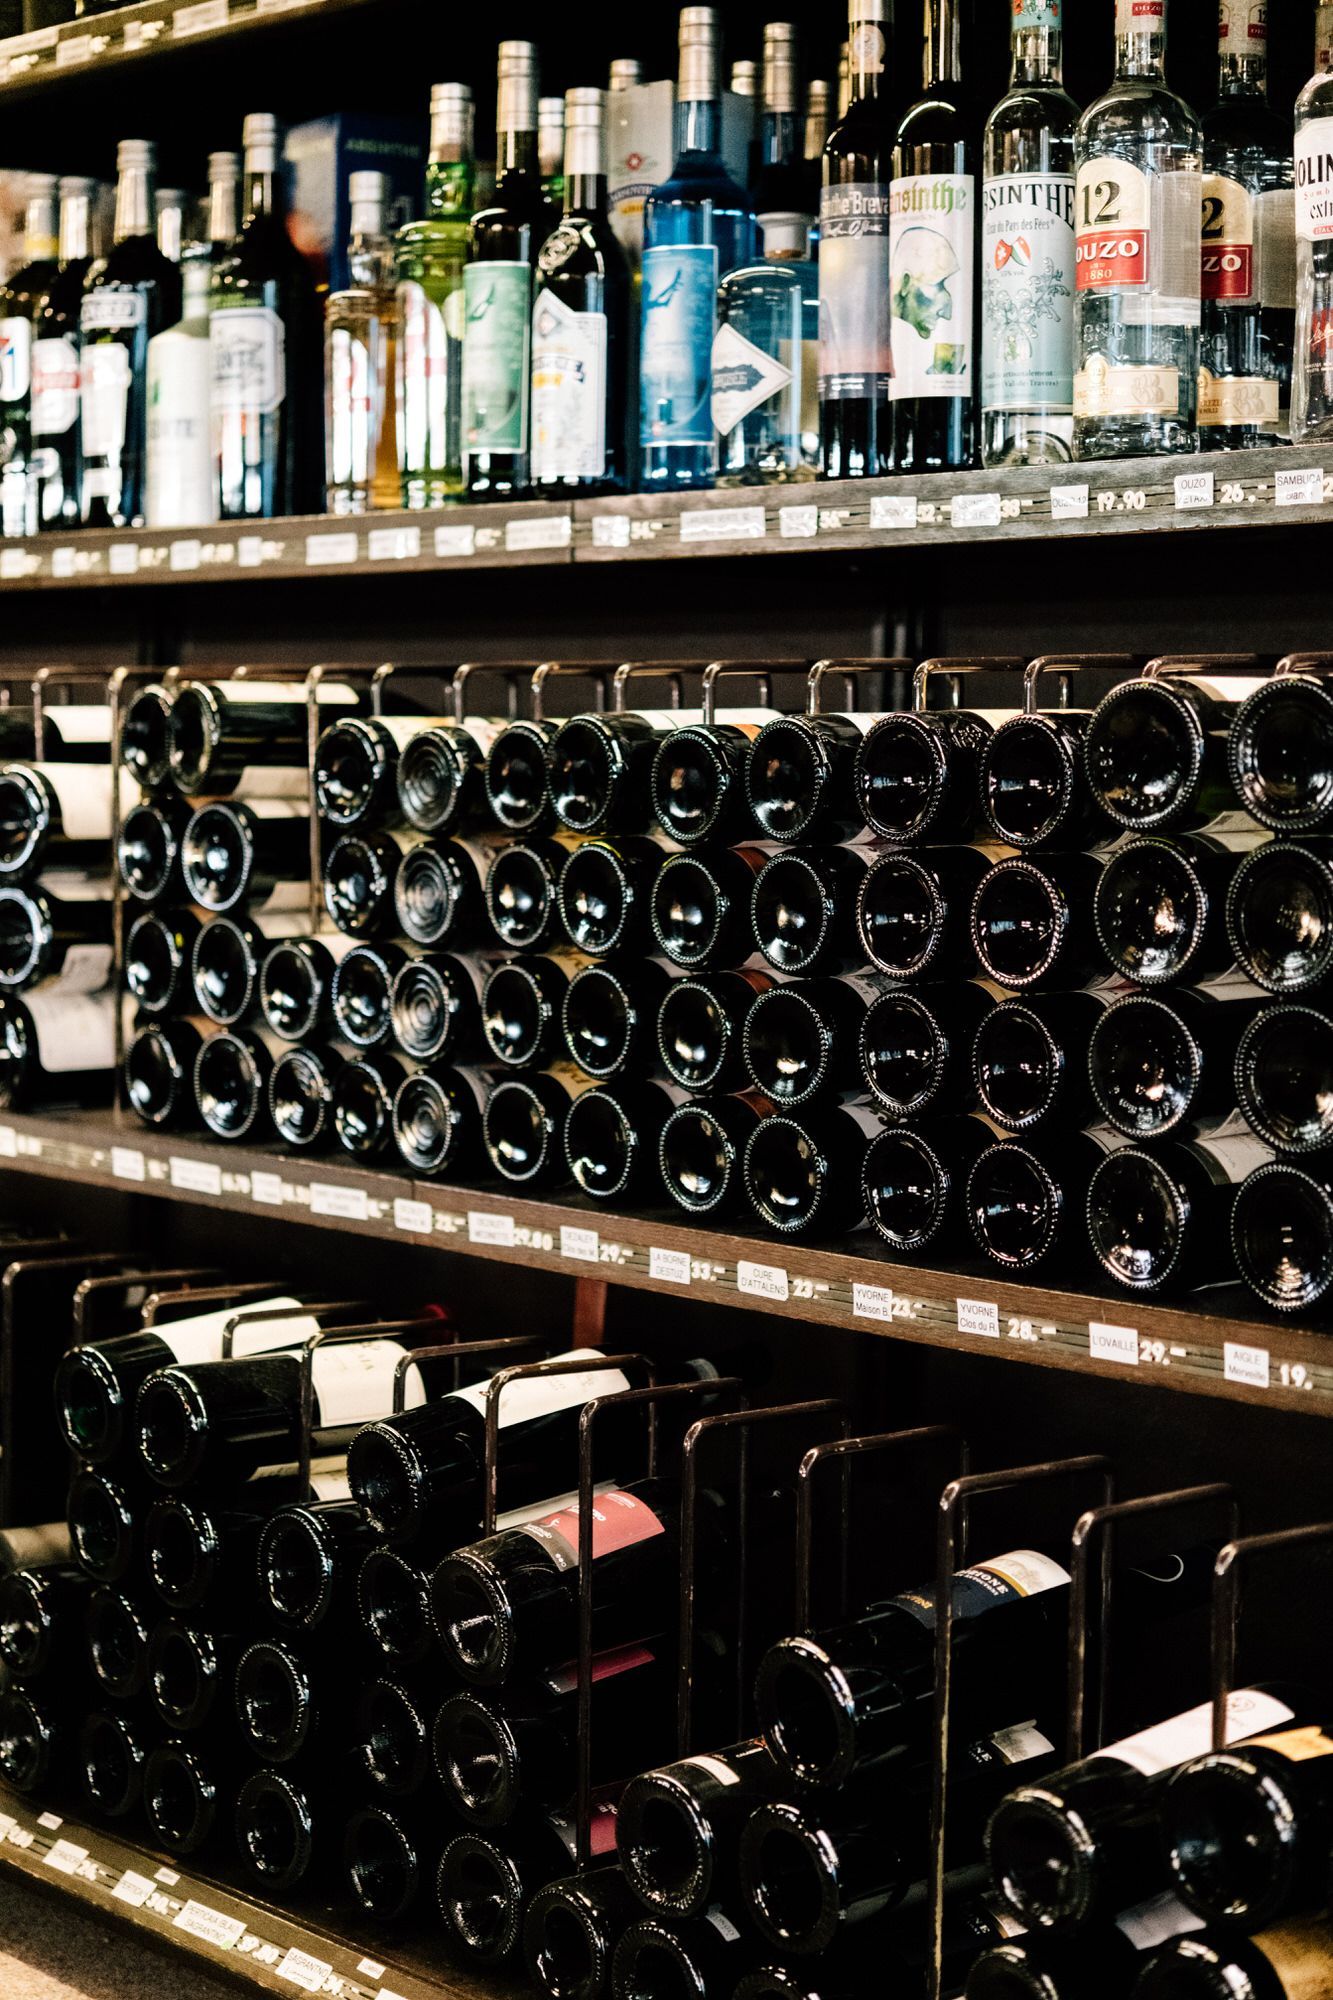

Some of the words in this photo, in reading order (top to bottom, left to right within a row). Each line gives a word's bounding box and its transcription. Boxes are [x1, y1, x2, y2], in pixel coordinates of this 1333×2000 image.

[1081, 181, 1121, 227] 12
[1076, 239, 1140, 263] OUZO
[1181, 477, 1207, 490] OUZO
[1097, 489, 1147, 512] 19.90
[753, 1268, 774, 1281] CURE
[856, 1288, 889, 1303] YVORNE
[856, 1302, 881, 1314] Maison
[960, 1303, 995, 1318] YVORNE
[960, 1317, 977, 1329] Clos
[978, 1320, 988, 1331] du
[1092, 1335, 1136, 1352] L'OVAILLE
[1232, 1351, 1262, 1366] AIGLE
